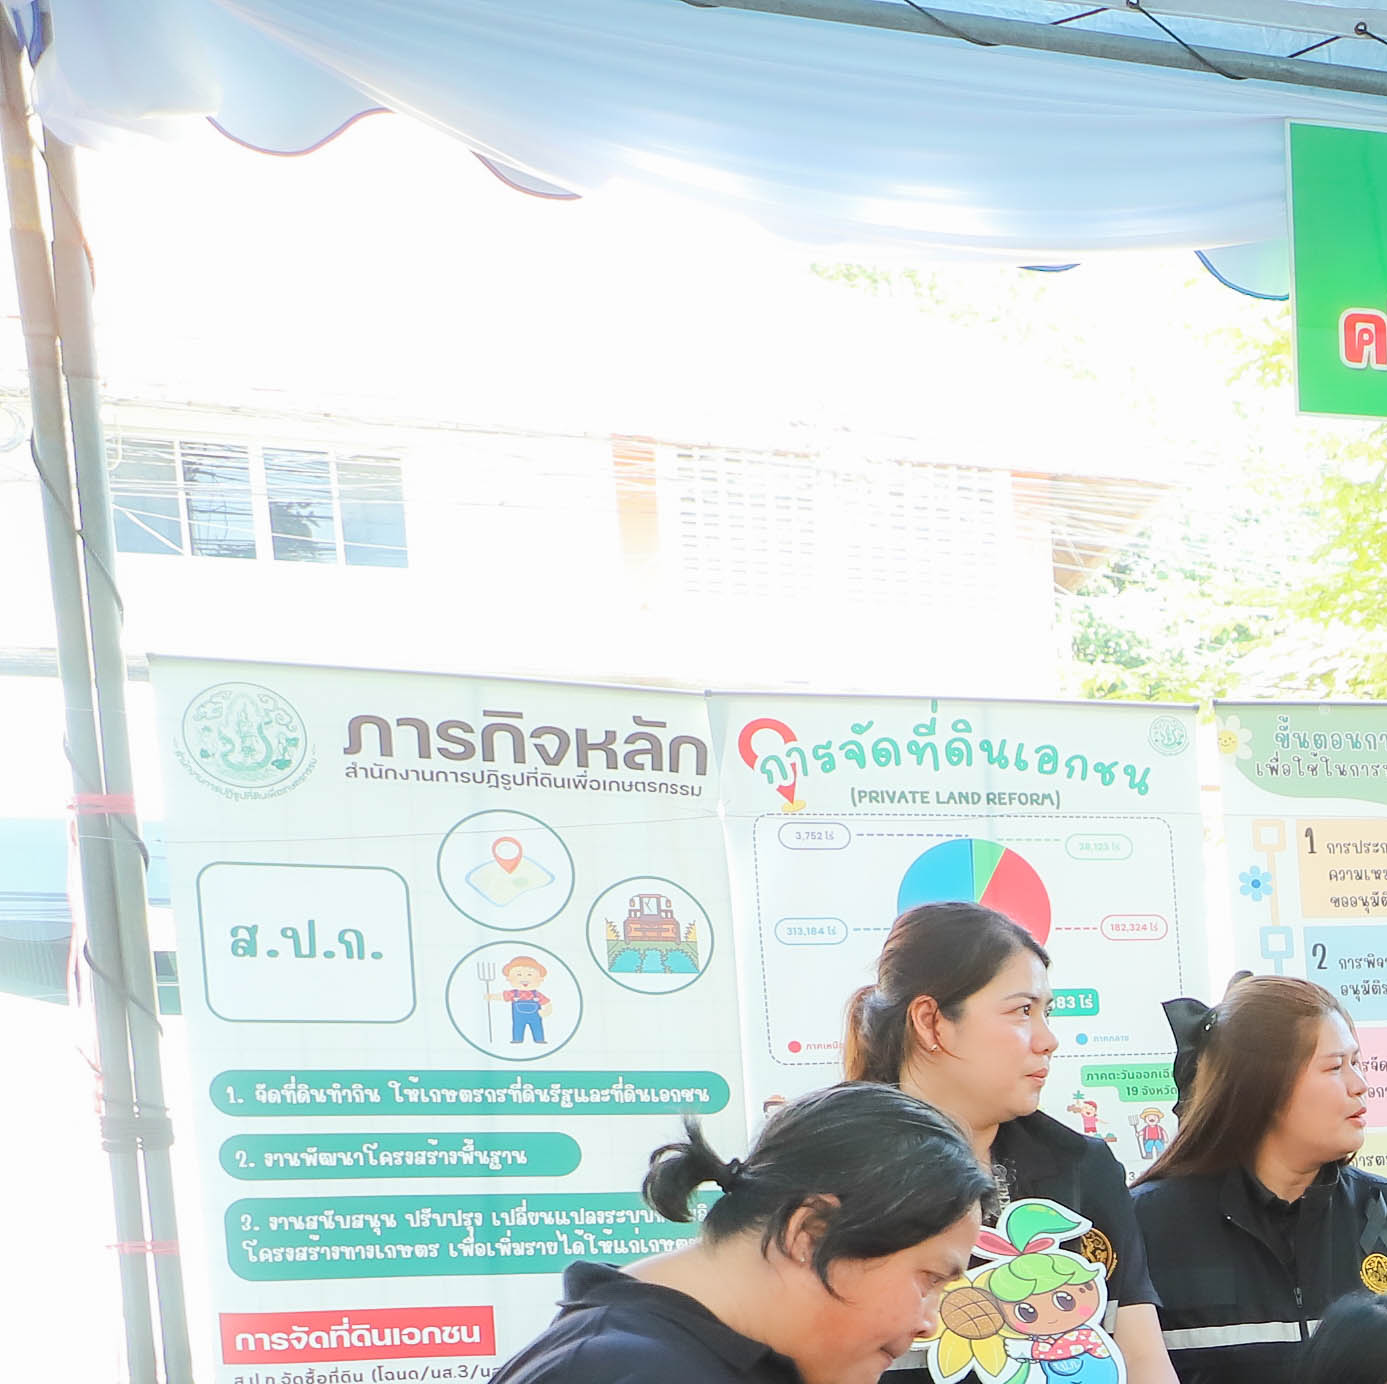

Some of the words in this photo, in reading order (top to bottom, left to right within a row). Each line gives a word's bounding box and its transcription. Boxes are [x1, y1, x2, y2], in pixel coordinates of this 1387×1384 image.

[343, 709, 708, 776] ภารกิจหลัก
[760, 699, 1151, 796] การจัดที่ดินเอกชน
[344, 761, 703, 797] สำนักงานการปฏิรูปที่ดินเพื่อเกษตรกรรม
[850, 787, 930, 808] (PRIVATE
[935, 790, 981, 806] LAND
[986, 789, 1061, 810] REFORM)
[1304, 827, 1318, 855] 1
[229, 918, 384, 961] ส.ป.ก.
[1311, 943, 1328, 970] 2
[1078, 993, 1094, 1009] ไร่
[1086, 1068, 1174, 1082] ภาคตะวันออกเฉี
[226, 1085, 244, 1104] 1.
[255, 1076, 381, 1105] จัดที่ดินทำกิน
[1126, 1086, 1139, 1097] 19
[235, 1149, 256, 1169] 2.
[264, 1138, 528, 1171] งานพัฒนาโครงสร้างพื้นฐาน
[241, 1213, 261, 1232] 3.
[269, 1208, 397, 1237] งานสนับสนุน
[405, 1207, 483, 1237] ปรับปรุง
[243, 1234, 440, 1263] โครงสร้างทางเกษตร
[235, 1318, 480, 1351] การจัดที่ดินเอกชน
